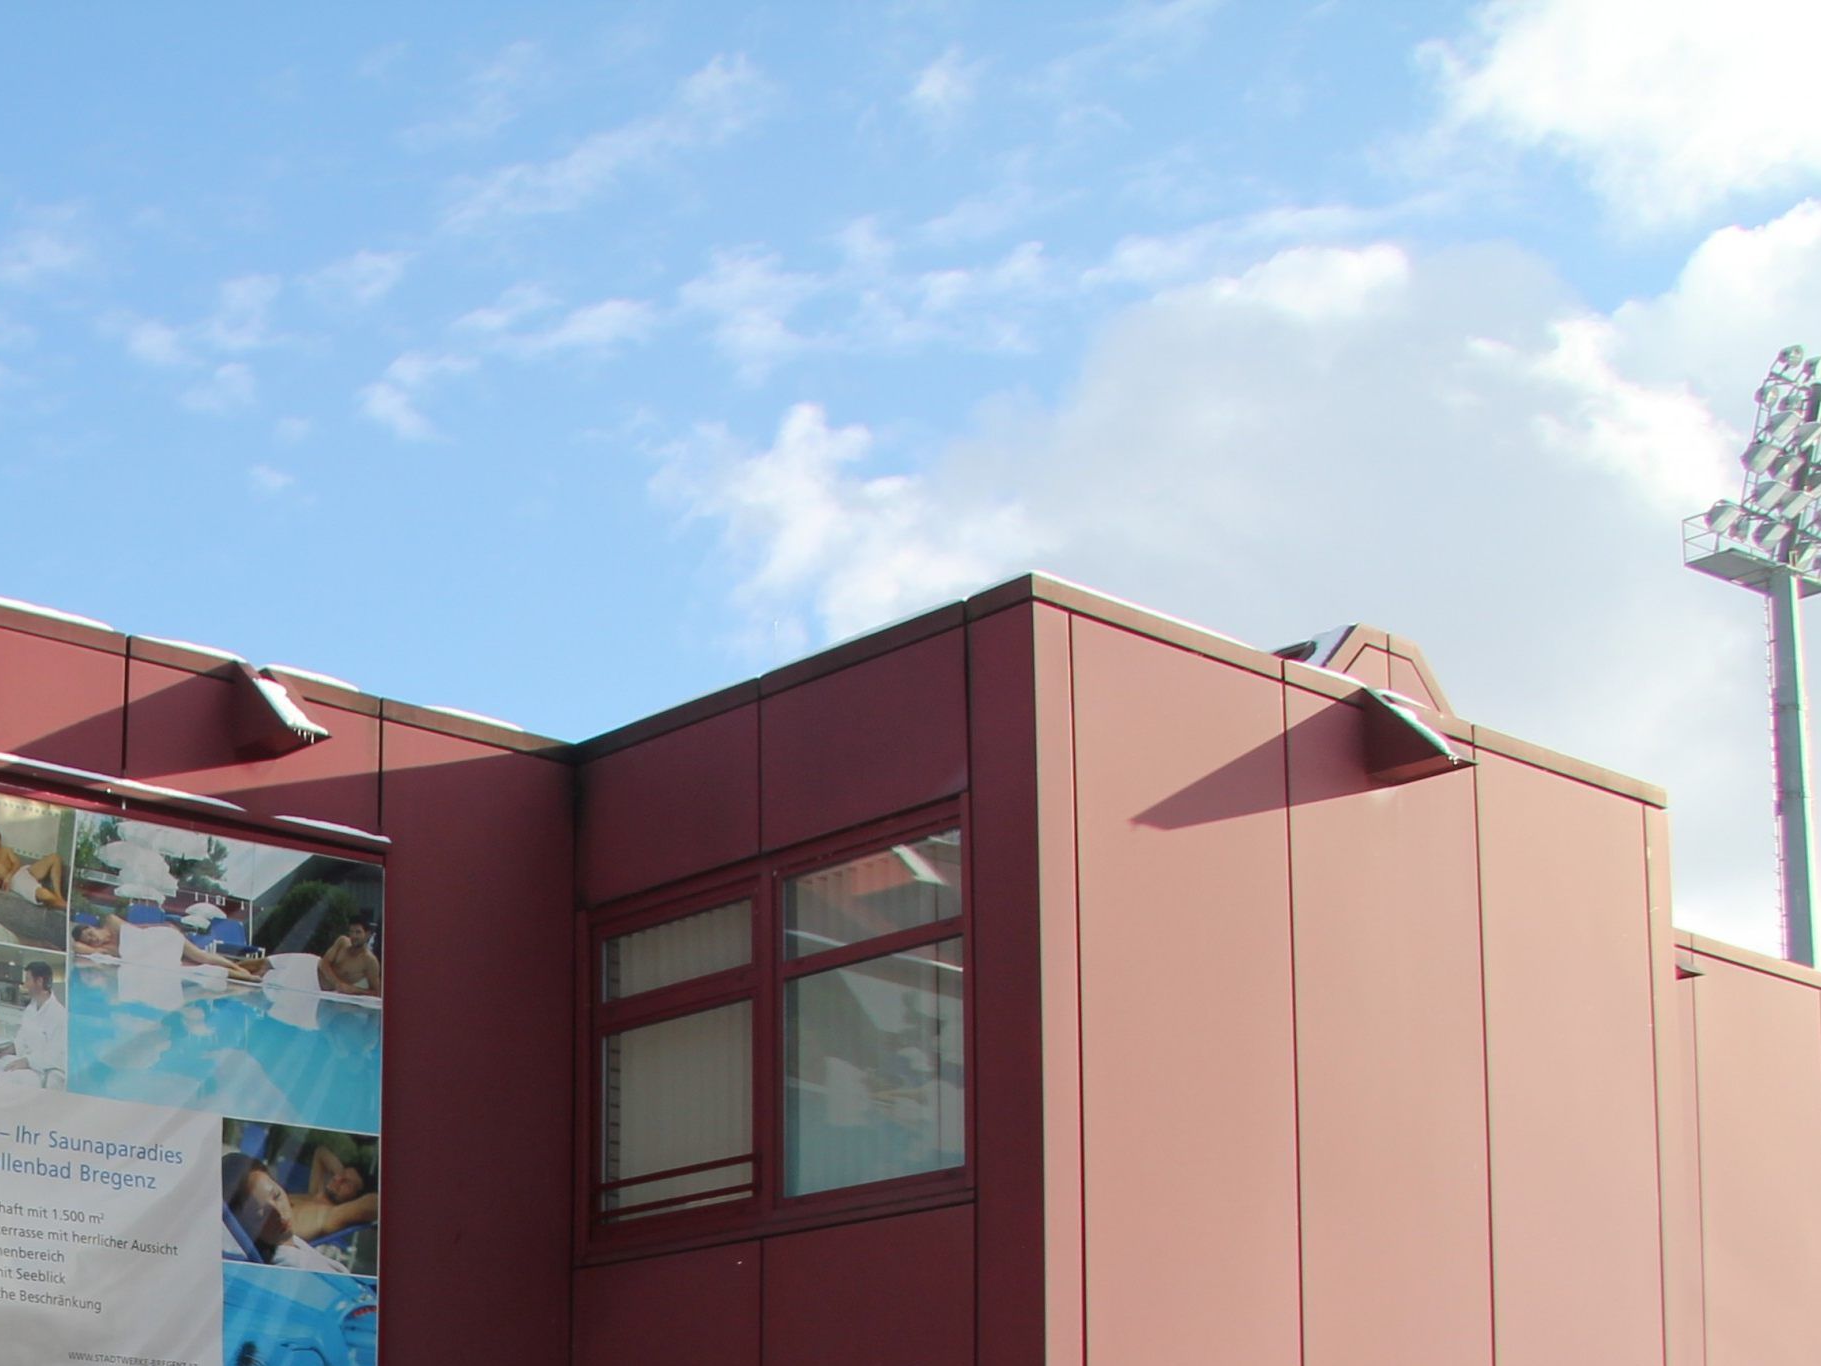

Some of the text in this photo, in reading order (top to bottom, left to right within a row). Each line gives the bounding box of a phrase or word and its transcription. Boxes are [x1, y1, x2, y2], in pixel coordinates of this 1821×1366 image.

[15, 1124, 41, 1146] Ihr
[48, 1130, 184, 1165] Saunaparadies
[79, 1163, 157, 1191] Bregenz
[27, 1206, 49, 1220] mit
[52, 1208, 86, 1223] 1.500
[47, 1229, 69, 1243] mit
[71, 1231, 129, 1250] herrlicher
[131, 1239, 180, 1257] Aussicht
[16, 1268, 67, 1285] Seeblick
[19, 1289, 102, 1314] Beschränkung
